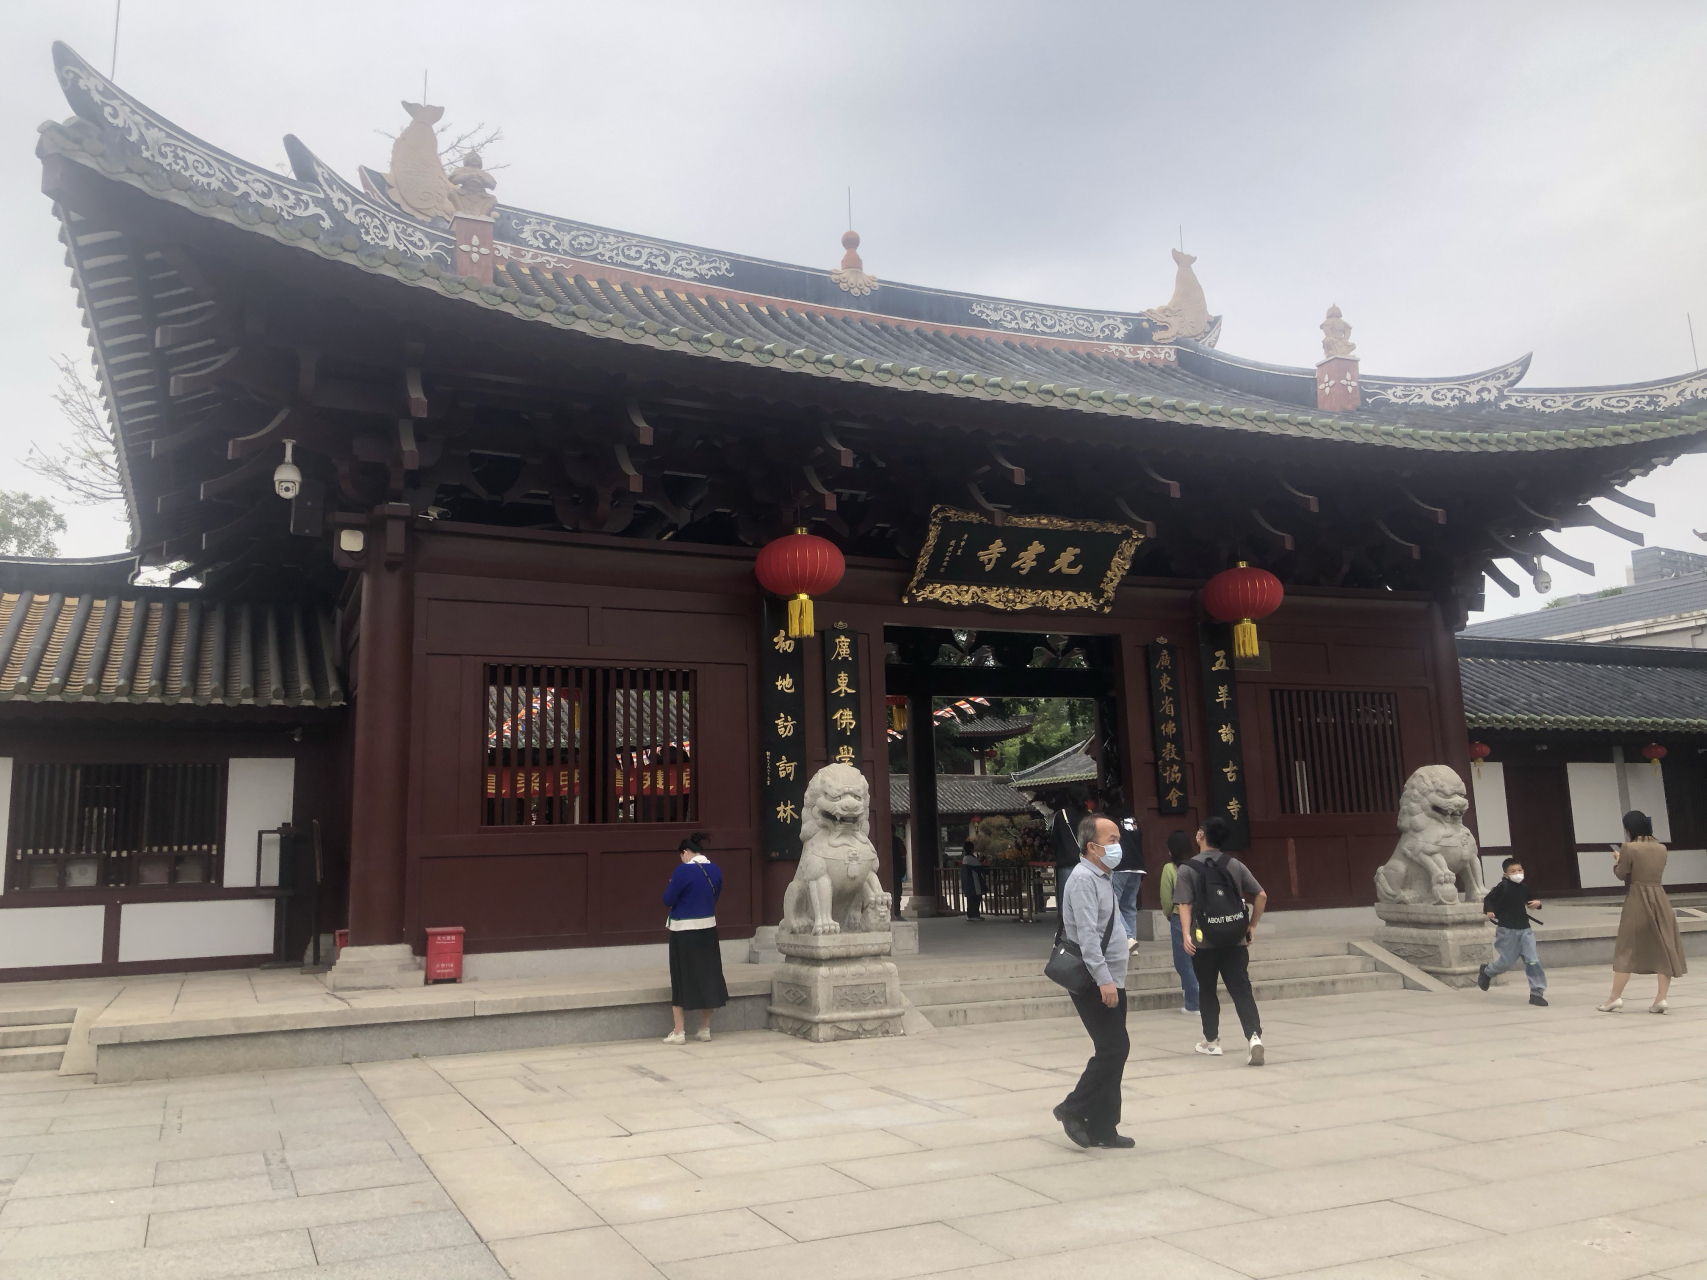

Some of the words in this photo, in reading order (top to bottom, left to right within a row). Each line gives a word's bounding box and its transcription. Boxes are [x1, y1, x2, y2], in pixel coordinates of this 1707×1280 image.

[773, 629, 799, 825] 初地訪訶林
[1155, 650, 1184, 807] 廣東省佛教協會
[1207, 916, 1225, 924] ABOUT
[1225, 911, 1244, 923] BEYOND
